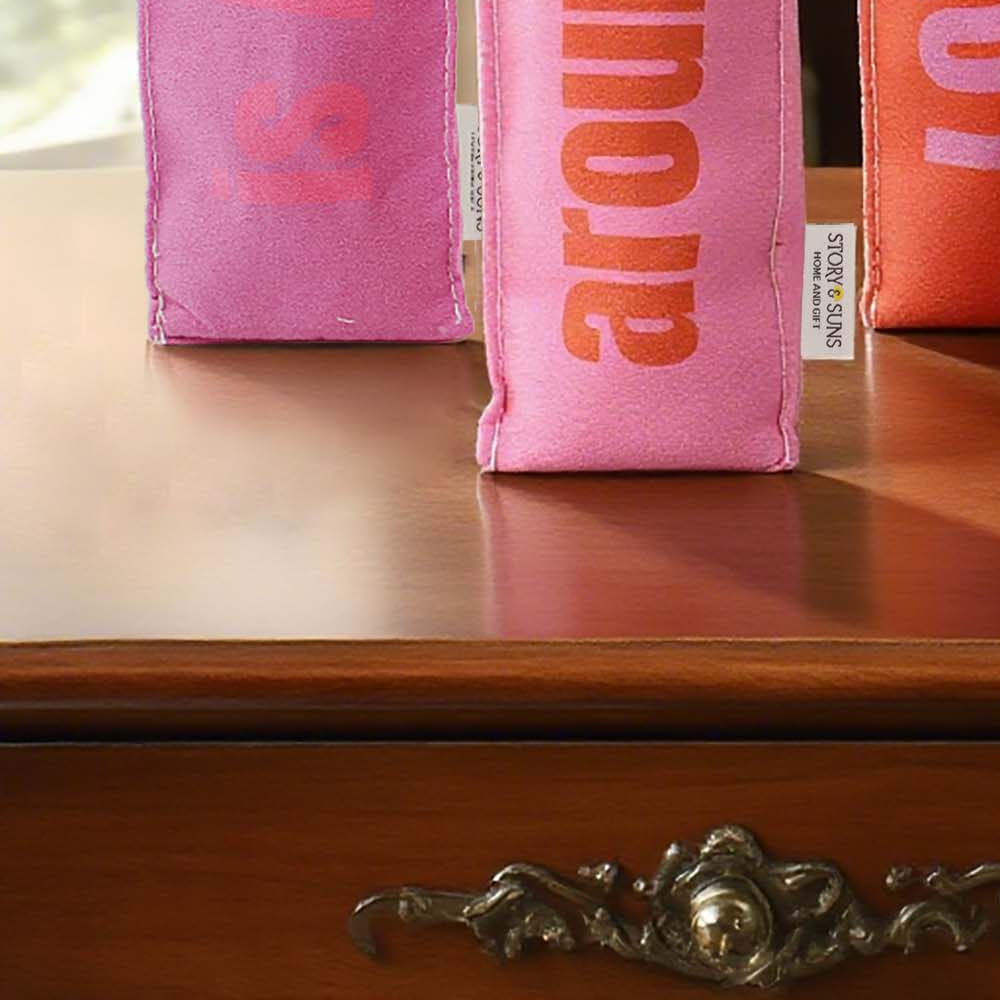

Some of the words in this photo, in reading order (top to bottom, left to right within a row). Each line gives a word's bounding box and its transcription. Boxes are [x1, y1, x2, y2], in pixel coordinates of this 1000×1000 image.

[812, 251, 821, 281] HOME
[825, 232, 843, 286] STORY
[812, 283, 821, 306] AND
[812, 307, 821, 329] GIFT
[826, 303, 842, 348] SUNS
